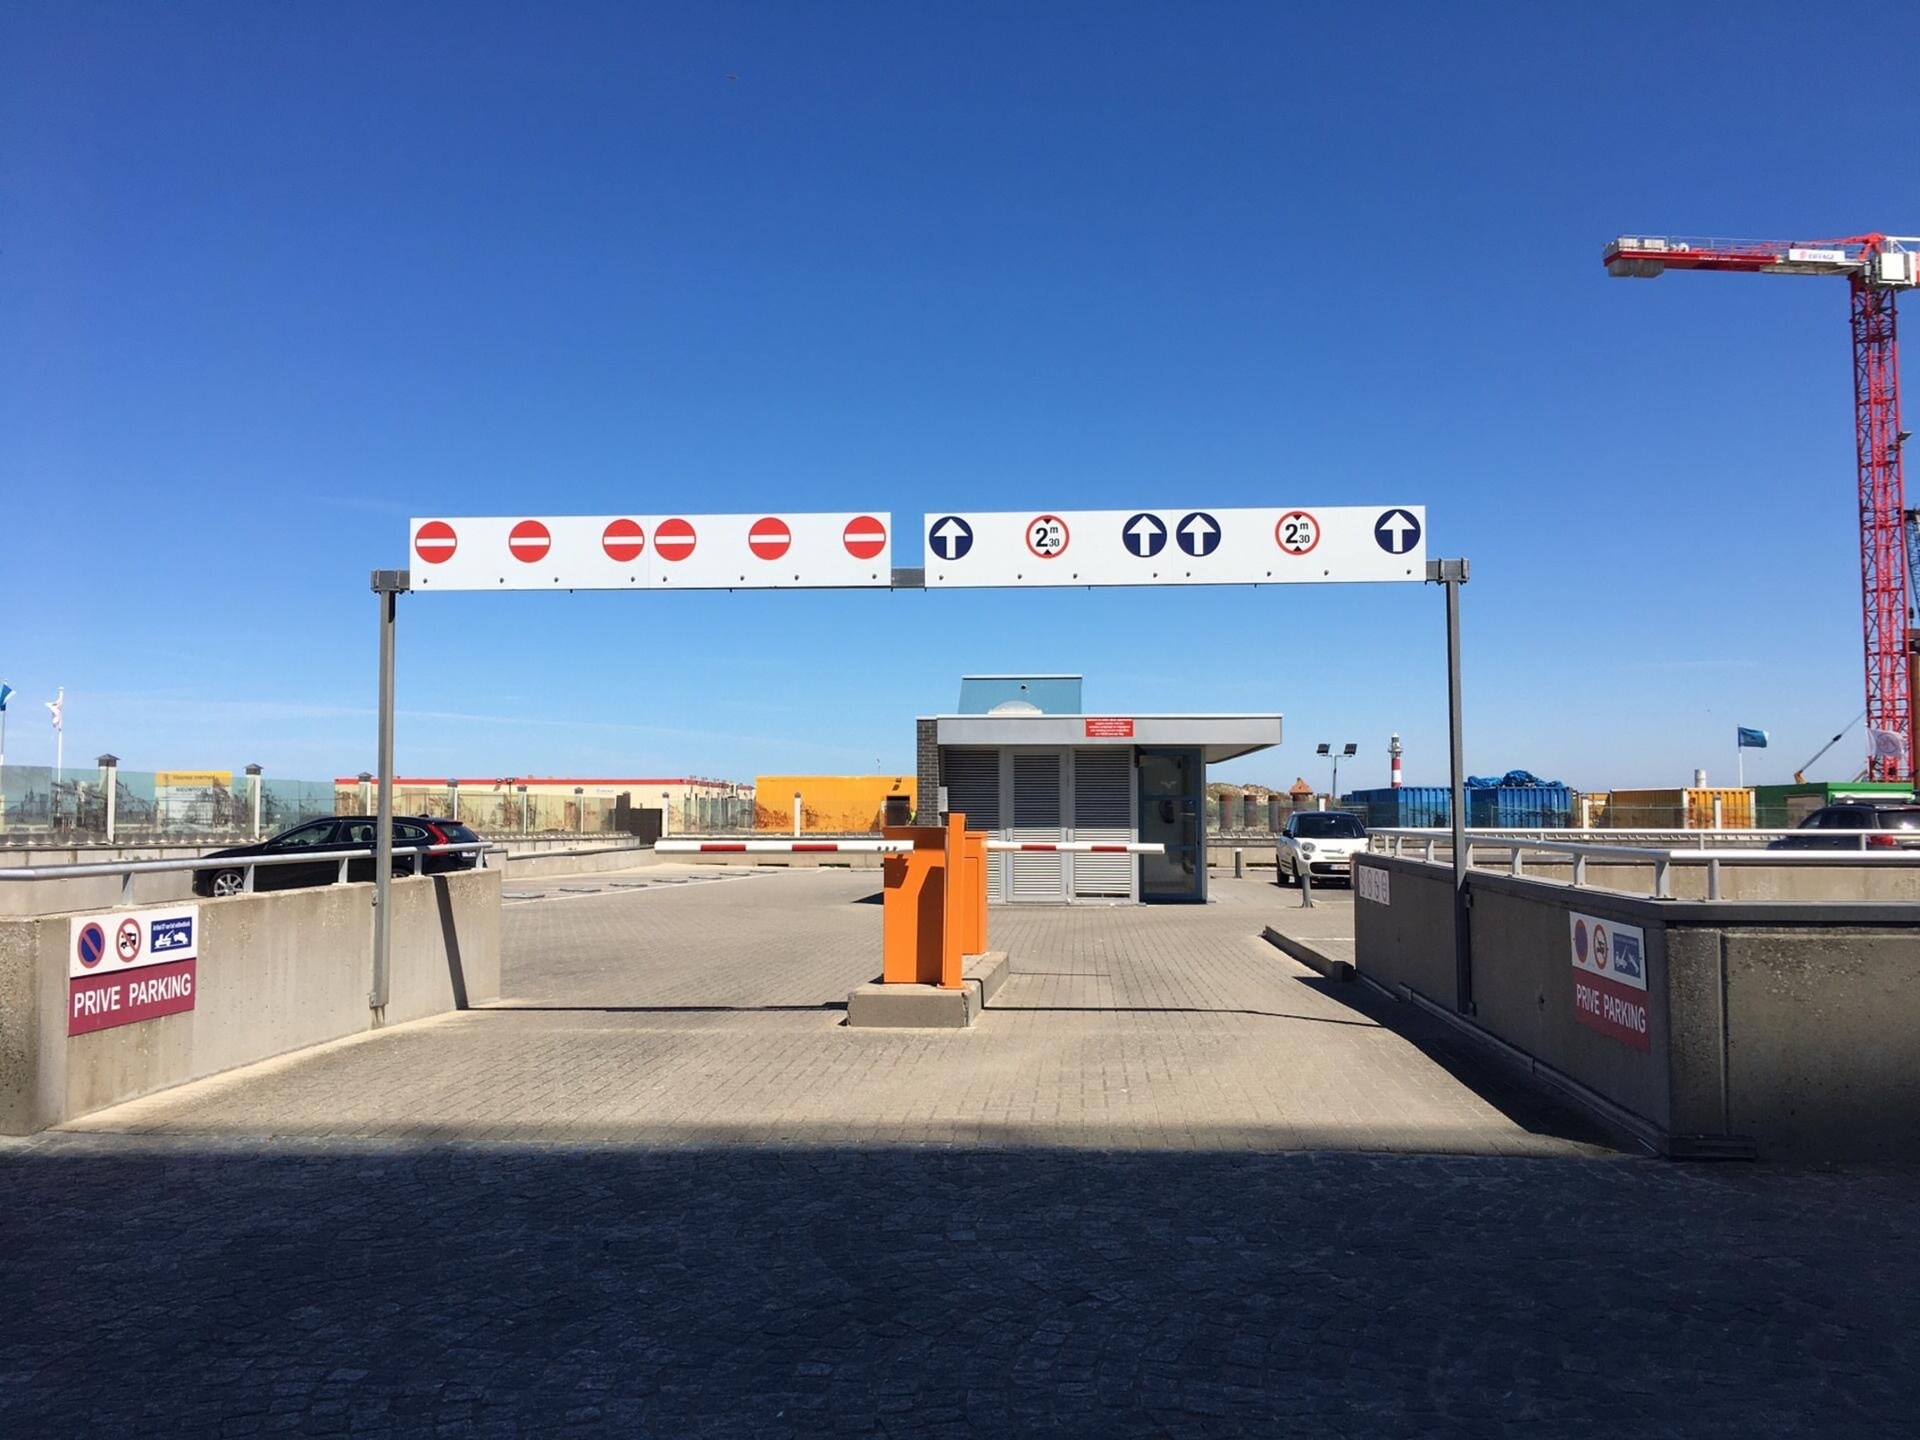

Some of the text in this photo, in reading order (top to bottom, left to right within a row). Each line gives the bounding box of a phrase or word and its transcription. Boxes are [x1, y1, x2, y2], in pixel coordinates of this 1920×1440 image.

[1035, 526, 1060, 548] 2 m 30
[1285, 522, 1310, 544] 2 m 30
[74, 973, 191, 1018] PRIVE PARKING
[1576, 984, 1646, 1033] PRIVE PARKING
